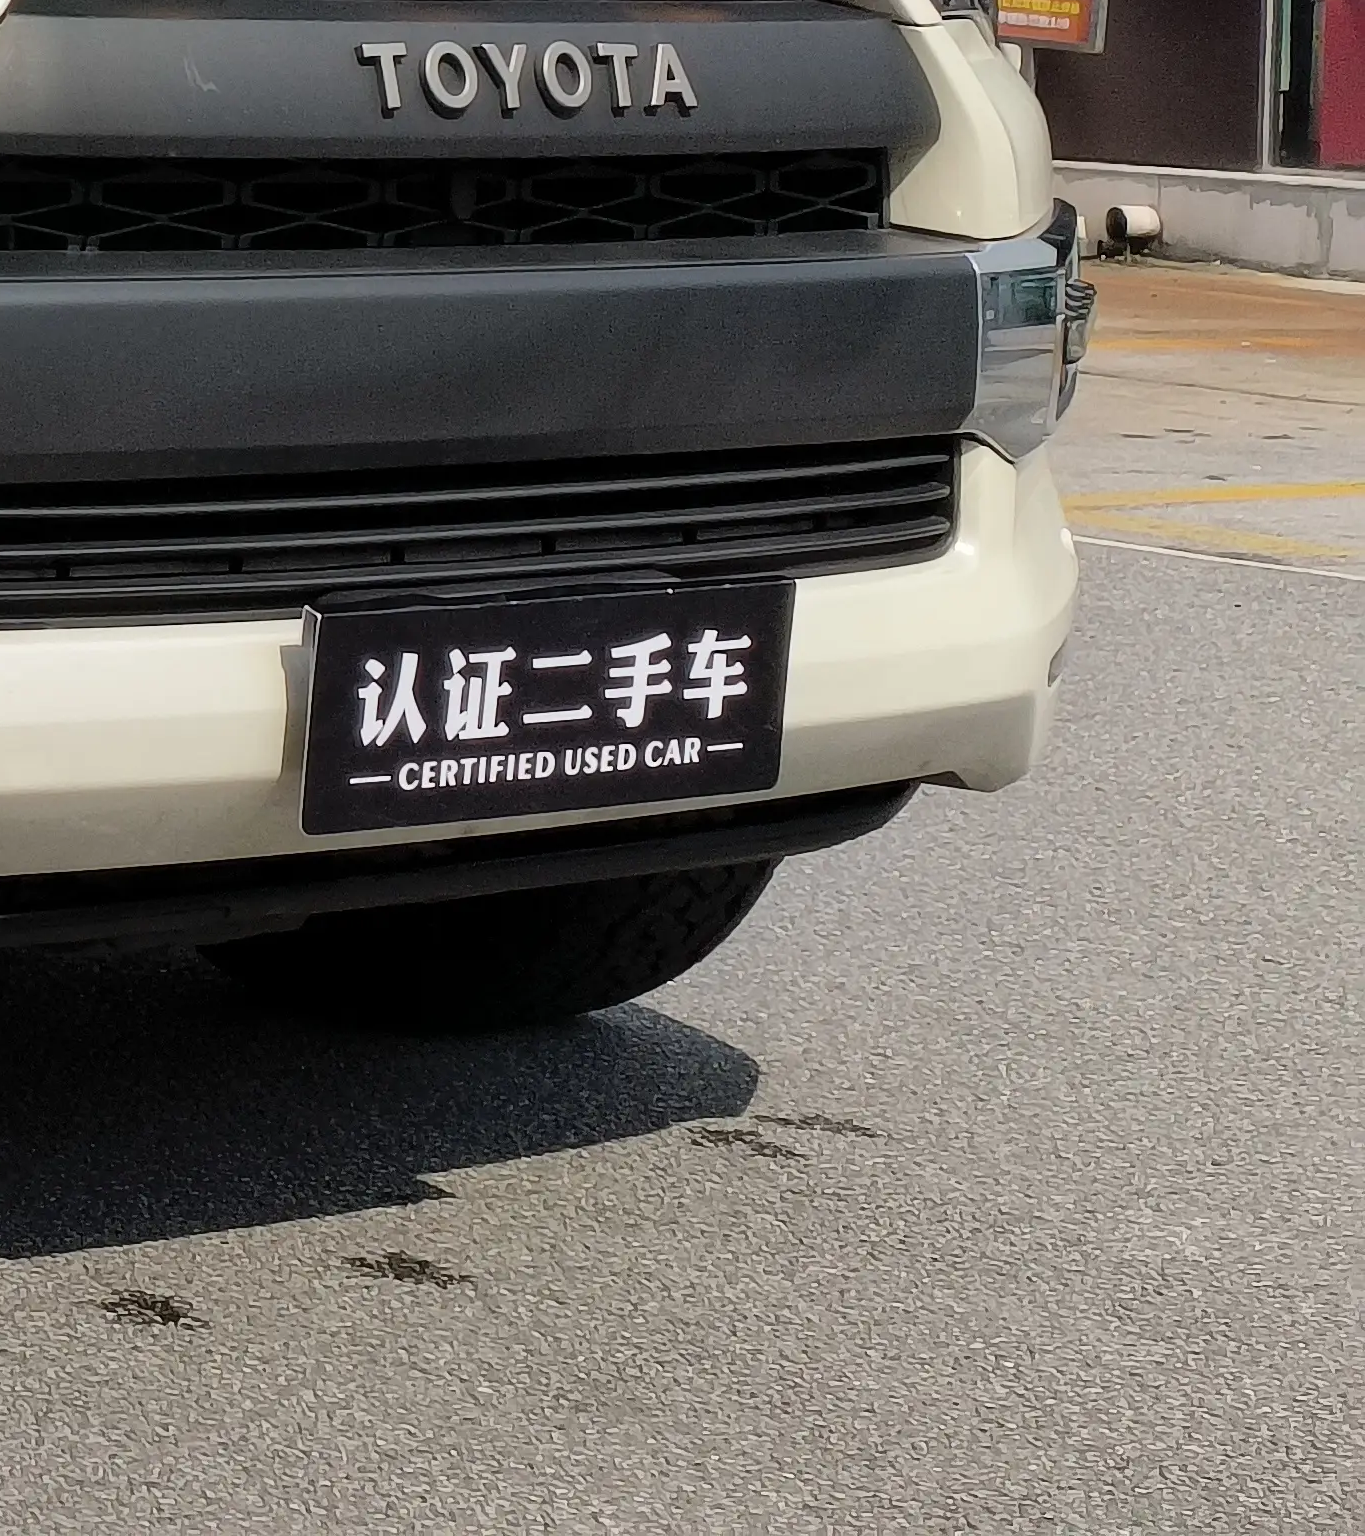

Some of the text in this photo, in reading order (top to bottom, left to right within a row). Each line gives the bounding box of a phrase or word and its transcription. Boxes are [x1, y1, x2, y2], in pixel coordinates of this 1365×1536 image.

[358, 40, 699, 116] TOYOTA
[357, 629, 752, 747] 认证二手车
[398, 737, 703, 791] CERTIFIED USED CAR
